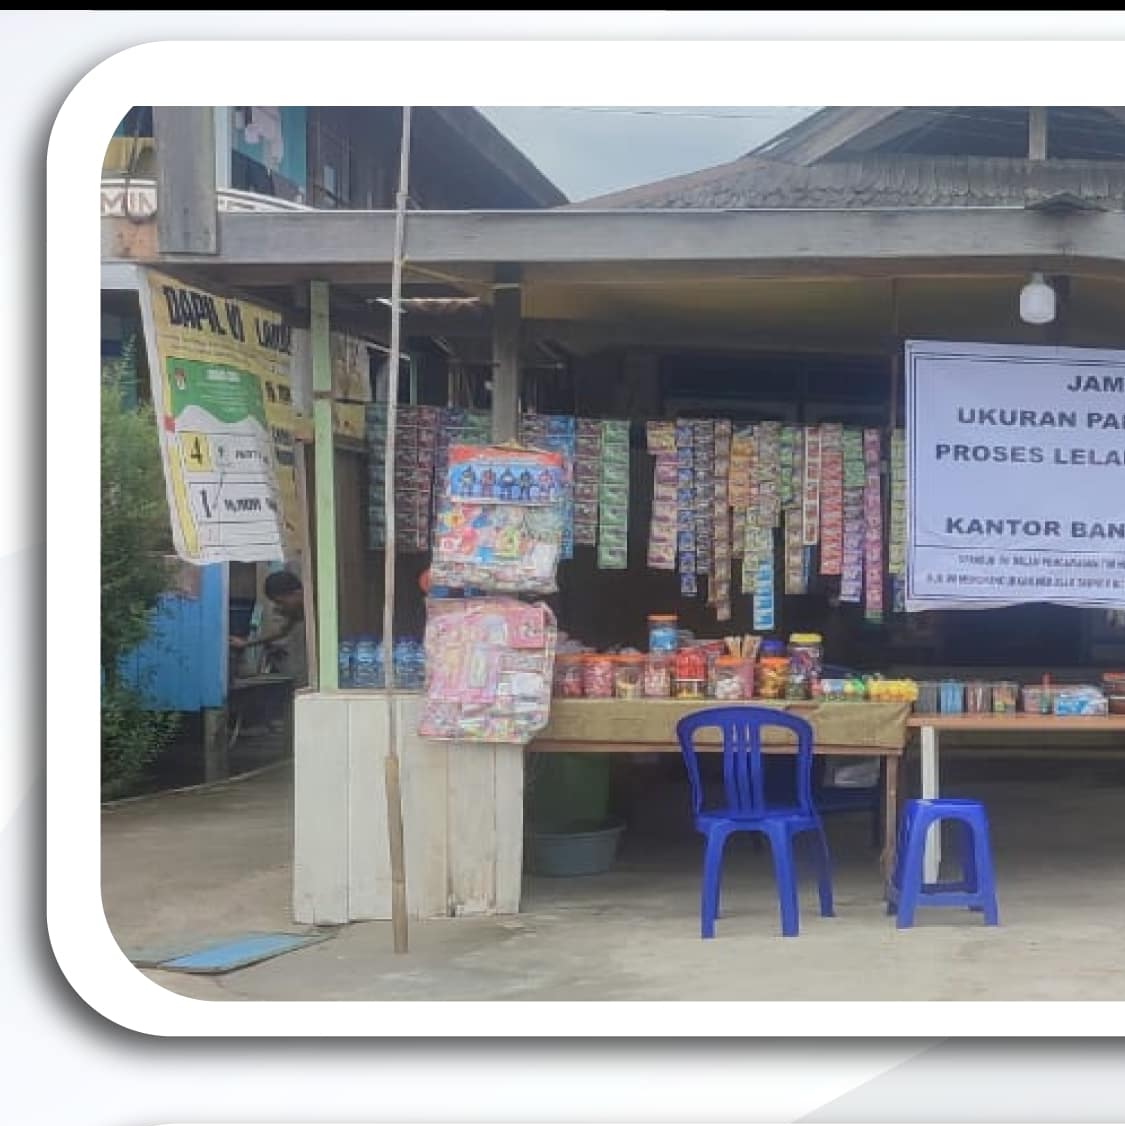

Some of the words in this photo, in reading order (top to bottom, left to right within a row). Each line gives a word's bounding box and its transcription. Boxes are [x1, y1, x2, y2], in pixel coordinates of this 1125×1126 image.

[163, 285, 226, 335] DAPIL
[959, 408, 1076, 427] UKURAN
[190, 436, 202, 464] 4
[936, 444, 1043, 462] PROSES
[946, 518, 1060, 536] KANTOR
